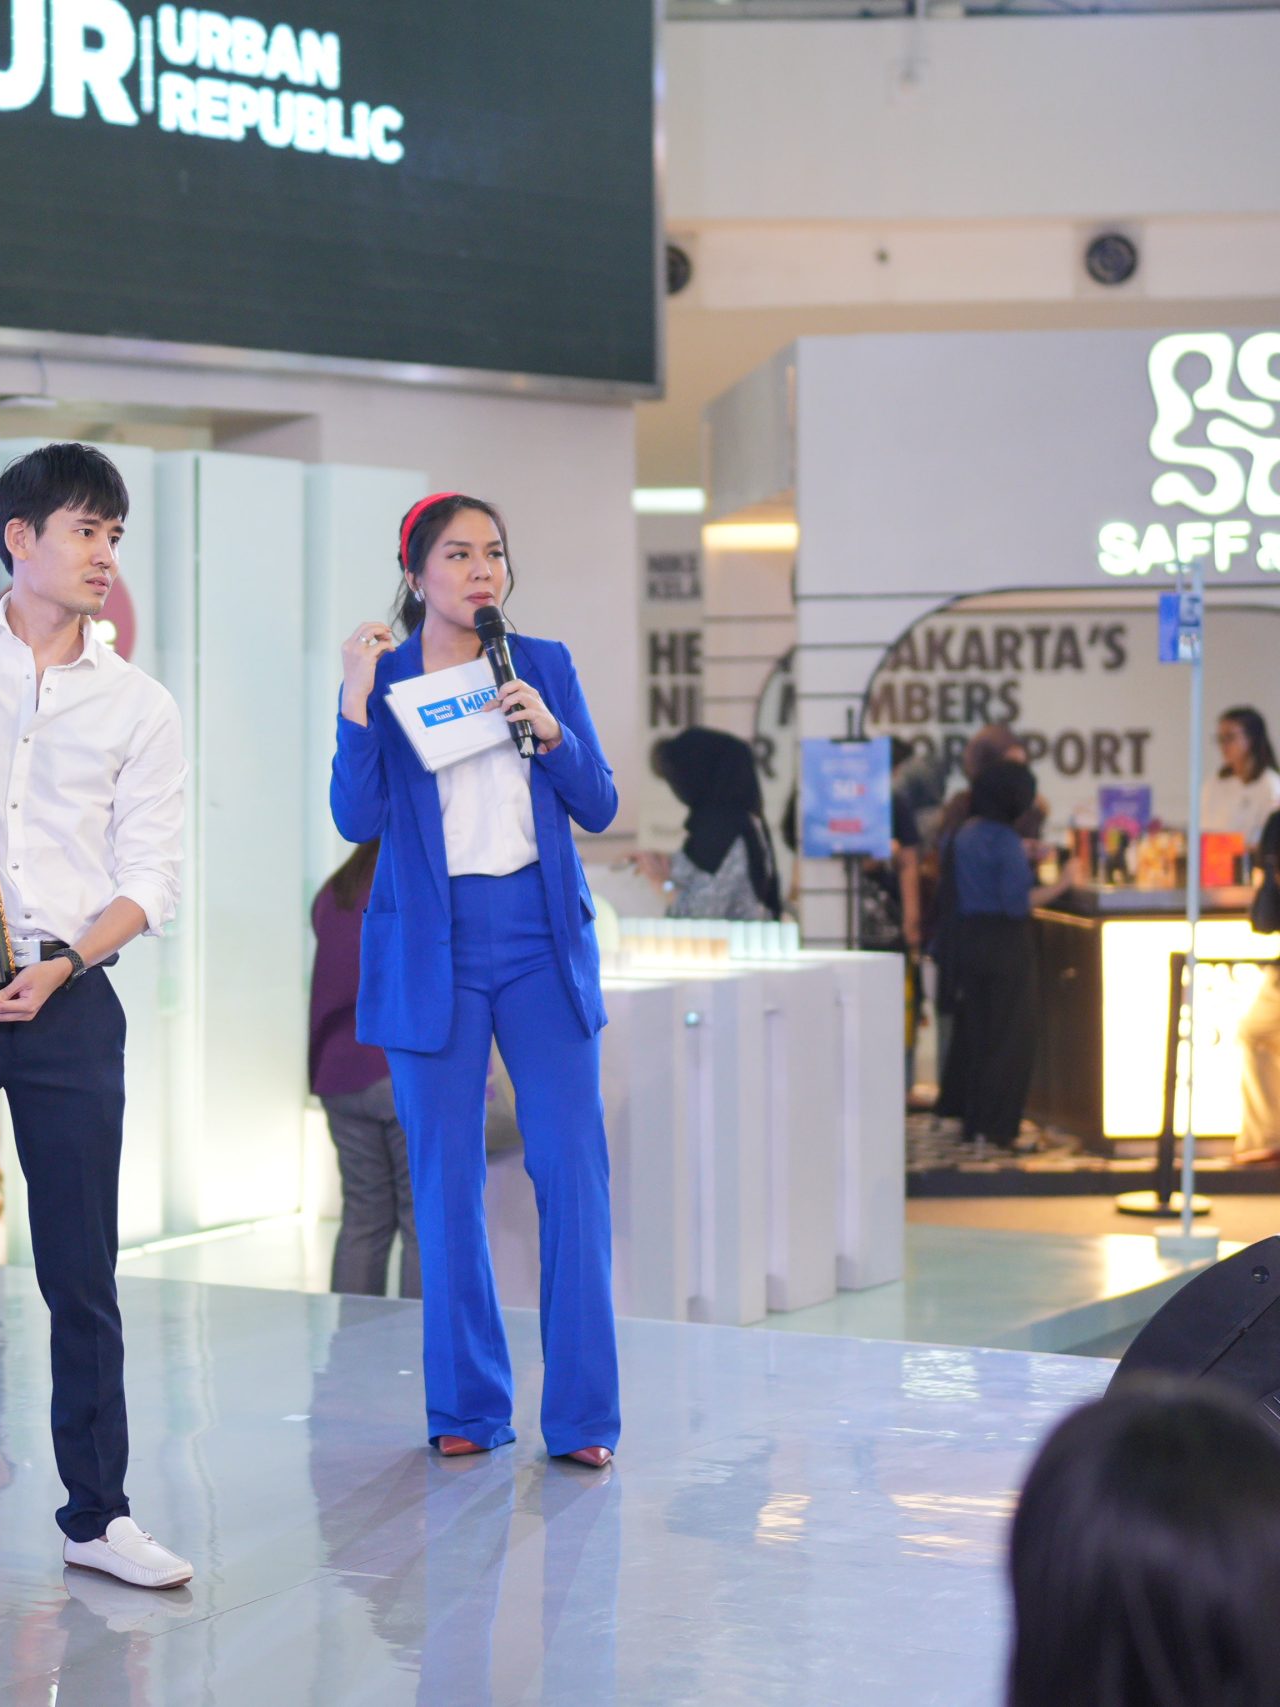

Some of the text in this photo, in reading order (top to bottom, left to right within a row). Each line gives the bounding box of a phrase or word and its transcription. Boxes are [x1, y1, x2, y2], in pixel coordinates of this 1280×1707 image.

[157, 4, 341, 90] URBAN
[157, 72, 404, 164] REPUBLIC
[1098, 520, 1251, 577] SAFF
[423, 703, 451, 717] beauty
